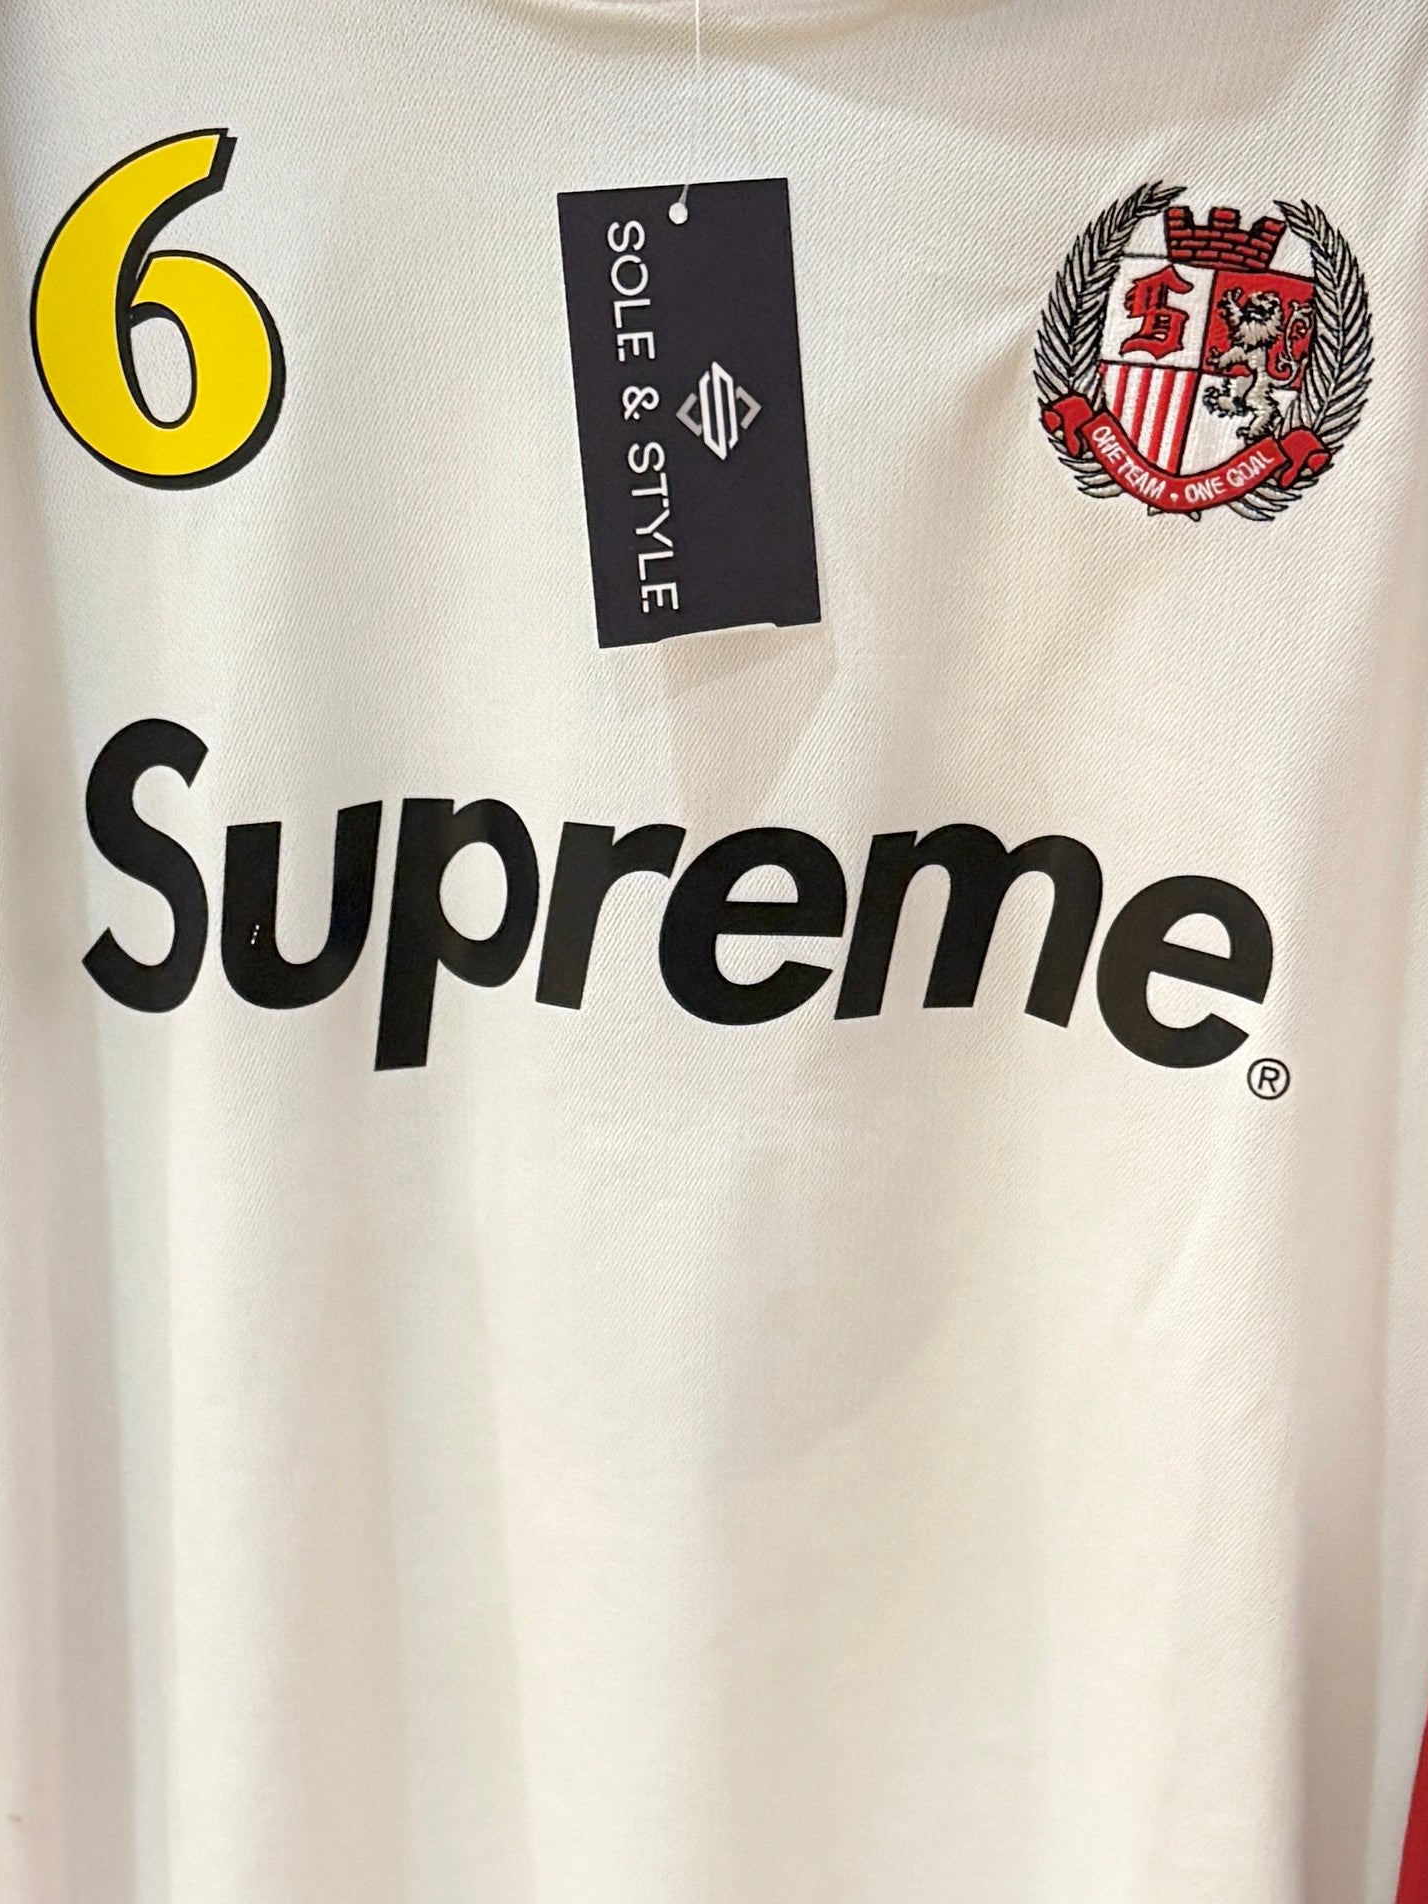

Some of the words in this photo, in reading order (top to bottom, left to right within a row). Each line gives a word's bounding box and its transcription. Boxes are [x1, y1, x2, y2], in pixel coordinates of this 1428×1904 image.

[30, 127, 287, 491] 6
[607, 219, 655, 362] SOLE
[622, 385, 660, 420] &
[1091, 425, 1125, 464] ONE
[1116, 455, 1167, 500] TEAM
[628, 441, 679, 614] STYLE
[1184, 475, 1227, 504] ONE
[1225, 450, 1275, 487] GOAL
[82, 718, 1273, 1072] Supreme
